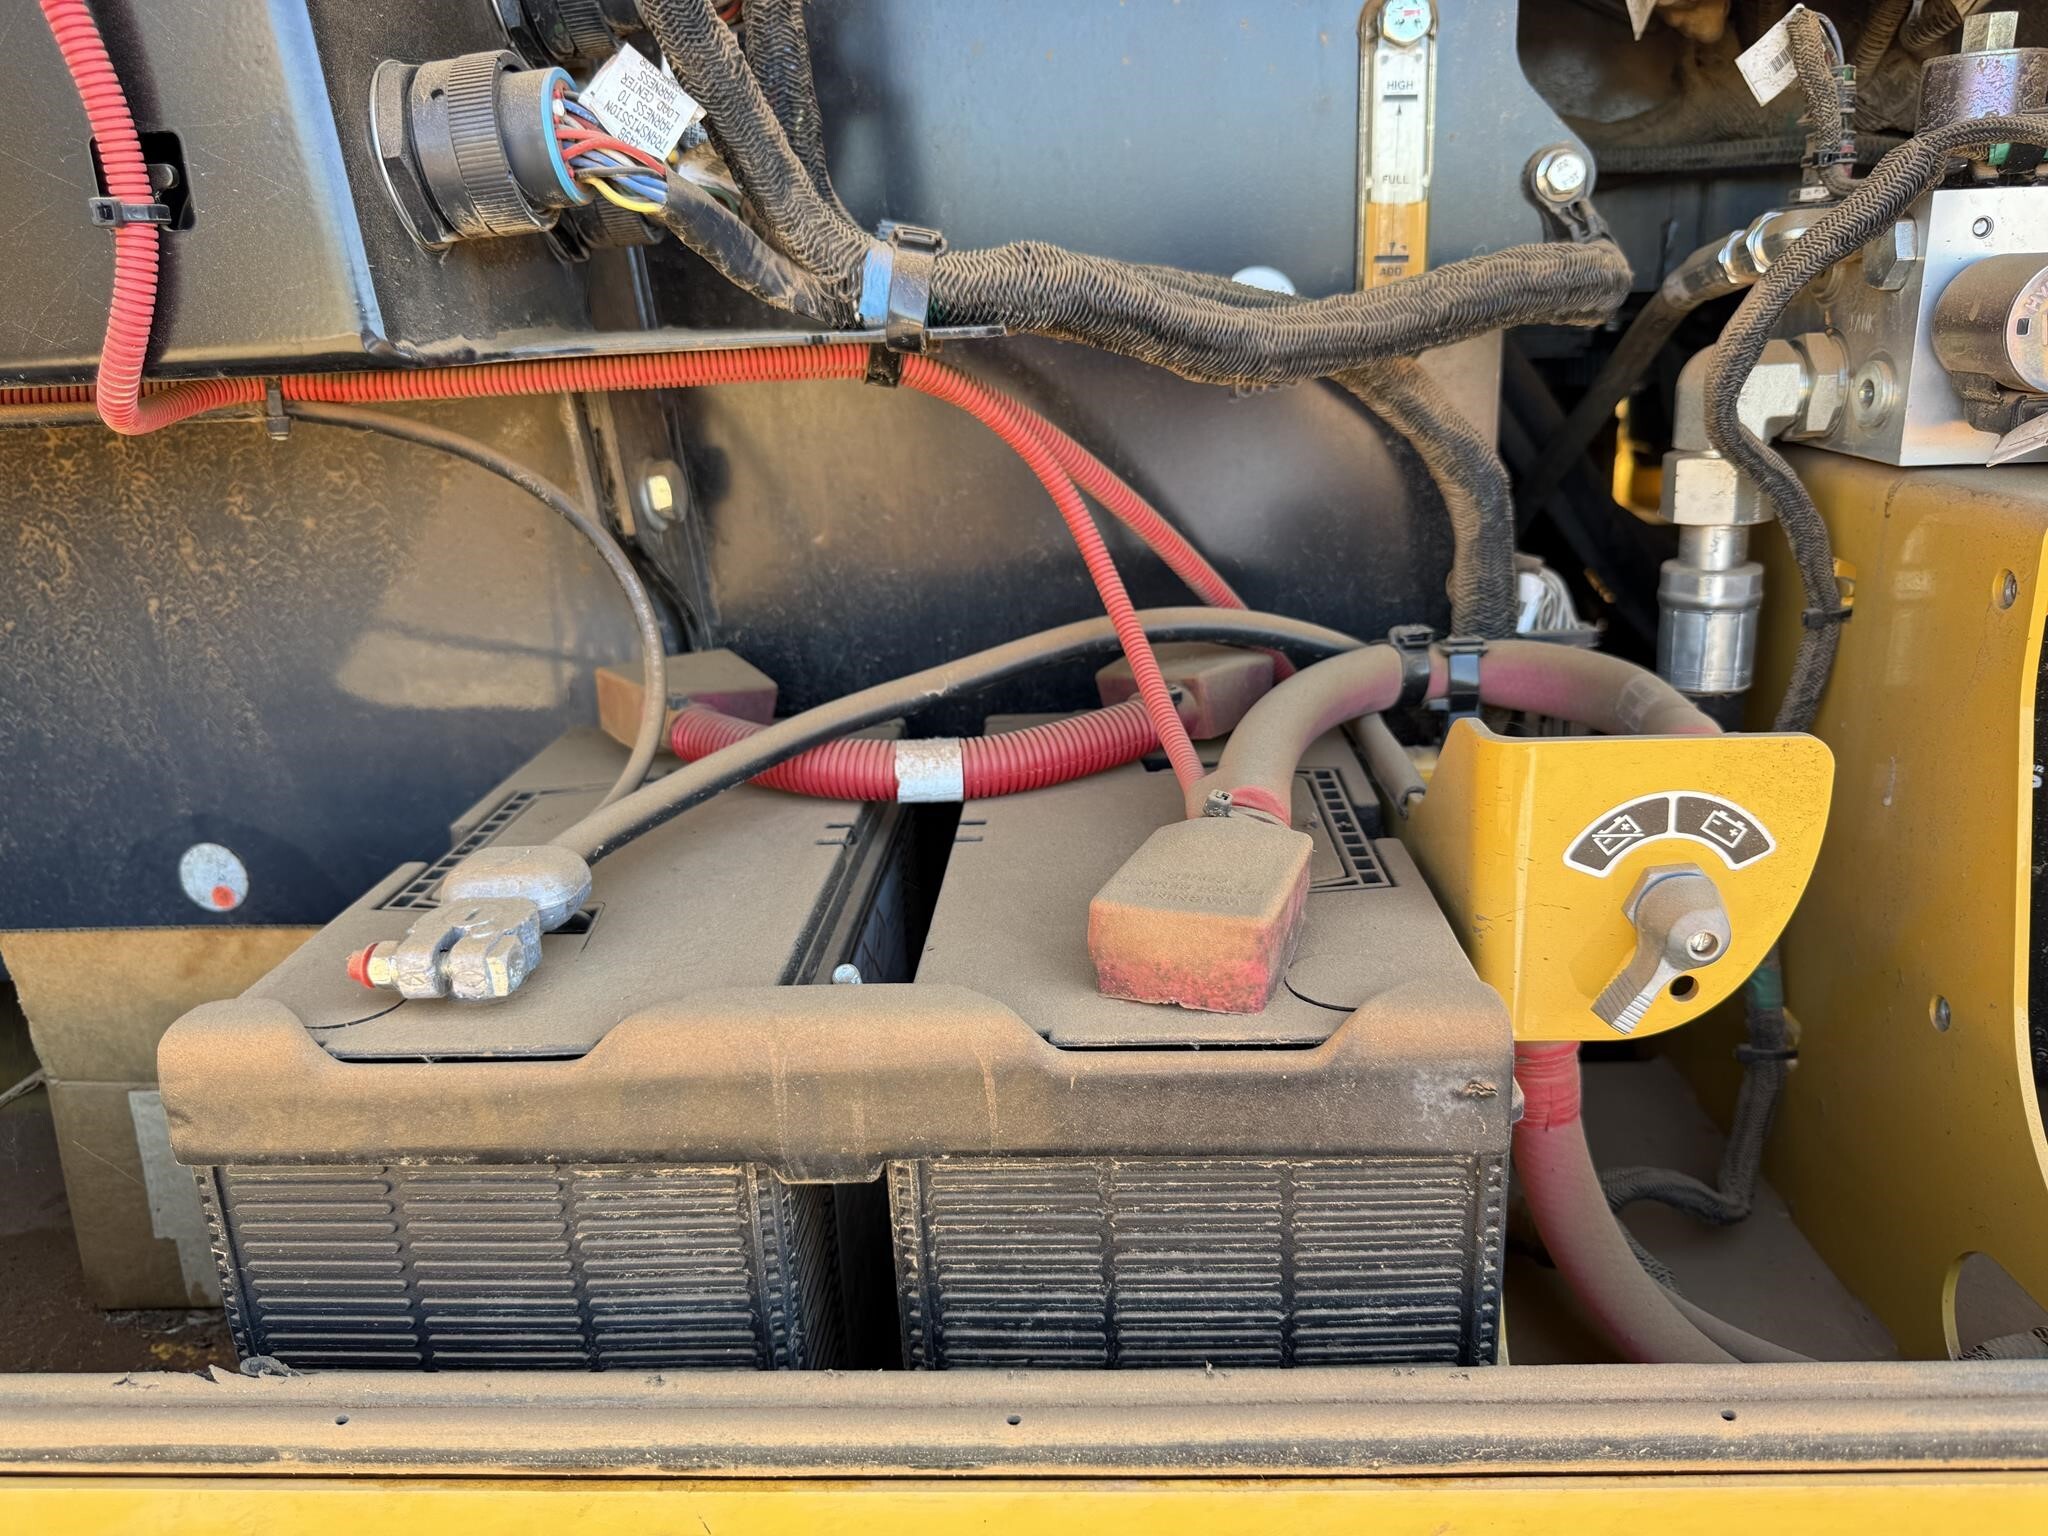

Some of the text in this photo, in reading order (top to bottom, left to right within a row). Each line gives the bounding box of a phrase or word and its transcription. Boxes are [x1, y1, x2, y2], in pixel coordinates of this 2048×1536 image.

[618, 90, 631, 106] TO
[620, 73, 680, 122] LOAD CENTER
[638, 70, 678, 104] HARNESS
[1387, 80, 1414, 90] HIGH
[604, 100, 668, 154] TRANSMISSION
[633, 101, 674, 136] HARNESS
[1382, 175, 1409, 185] FULL
